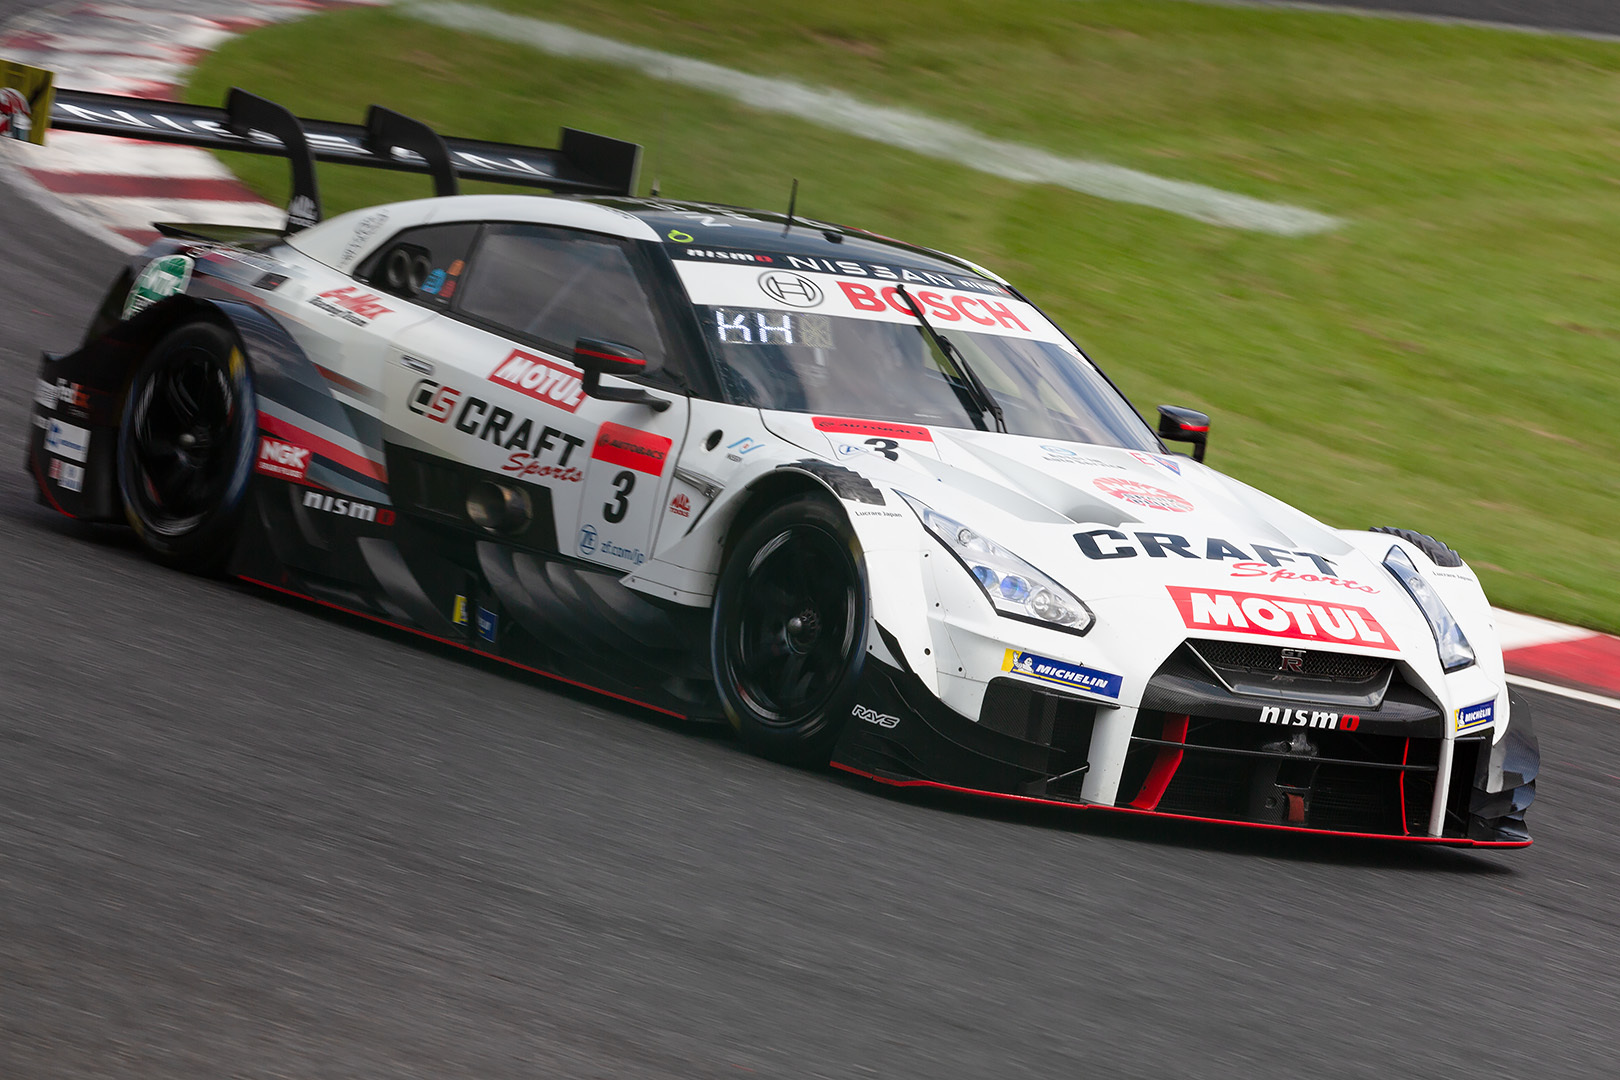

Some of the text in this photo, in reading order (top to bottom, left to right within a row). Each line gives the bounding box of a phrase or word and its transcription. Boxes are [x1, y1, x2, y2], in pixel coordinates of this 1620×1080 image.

[786, 255, 956, 288] NISSAN
[835, 280, 1032, 332] BOSCH
[715, 309, 793, 344] KH
[493, 355, 584, 407] MOTUL
[455, 396, 586, 467] CRAFT
[261, 440, 310, 469] NGK
[863, 438, 899, 461] 3
[501, 453, 585, 484] Sports
[302, 490, 396, 527] nismo
[602, 470, 636, 524] 3
[883, 510, 903, 518] Japan
[1072, 529, 1339, 578] CRAFT
[1230, 562, 1381, 595] Sports
[1190, 592, 1386, 643] MOTUL
[1035, 663, 1109, 689] MICHELIN
[851, 703, 900, 729] RAYS
[1259, 705, 1360, 731] nismo
[1465, 706, 1492, 723] MICHELIN
